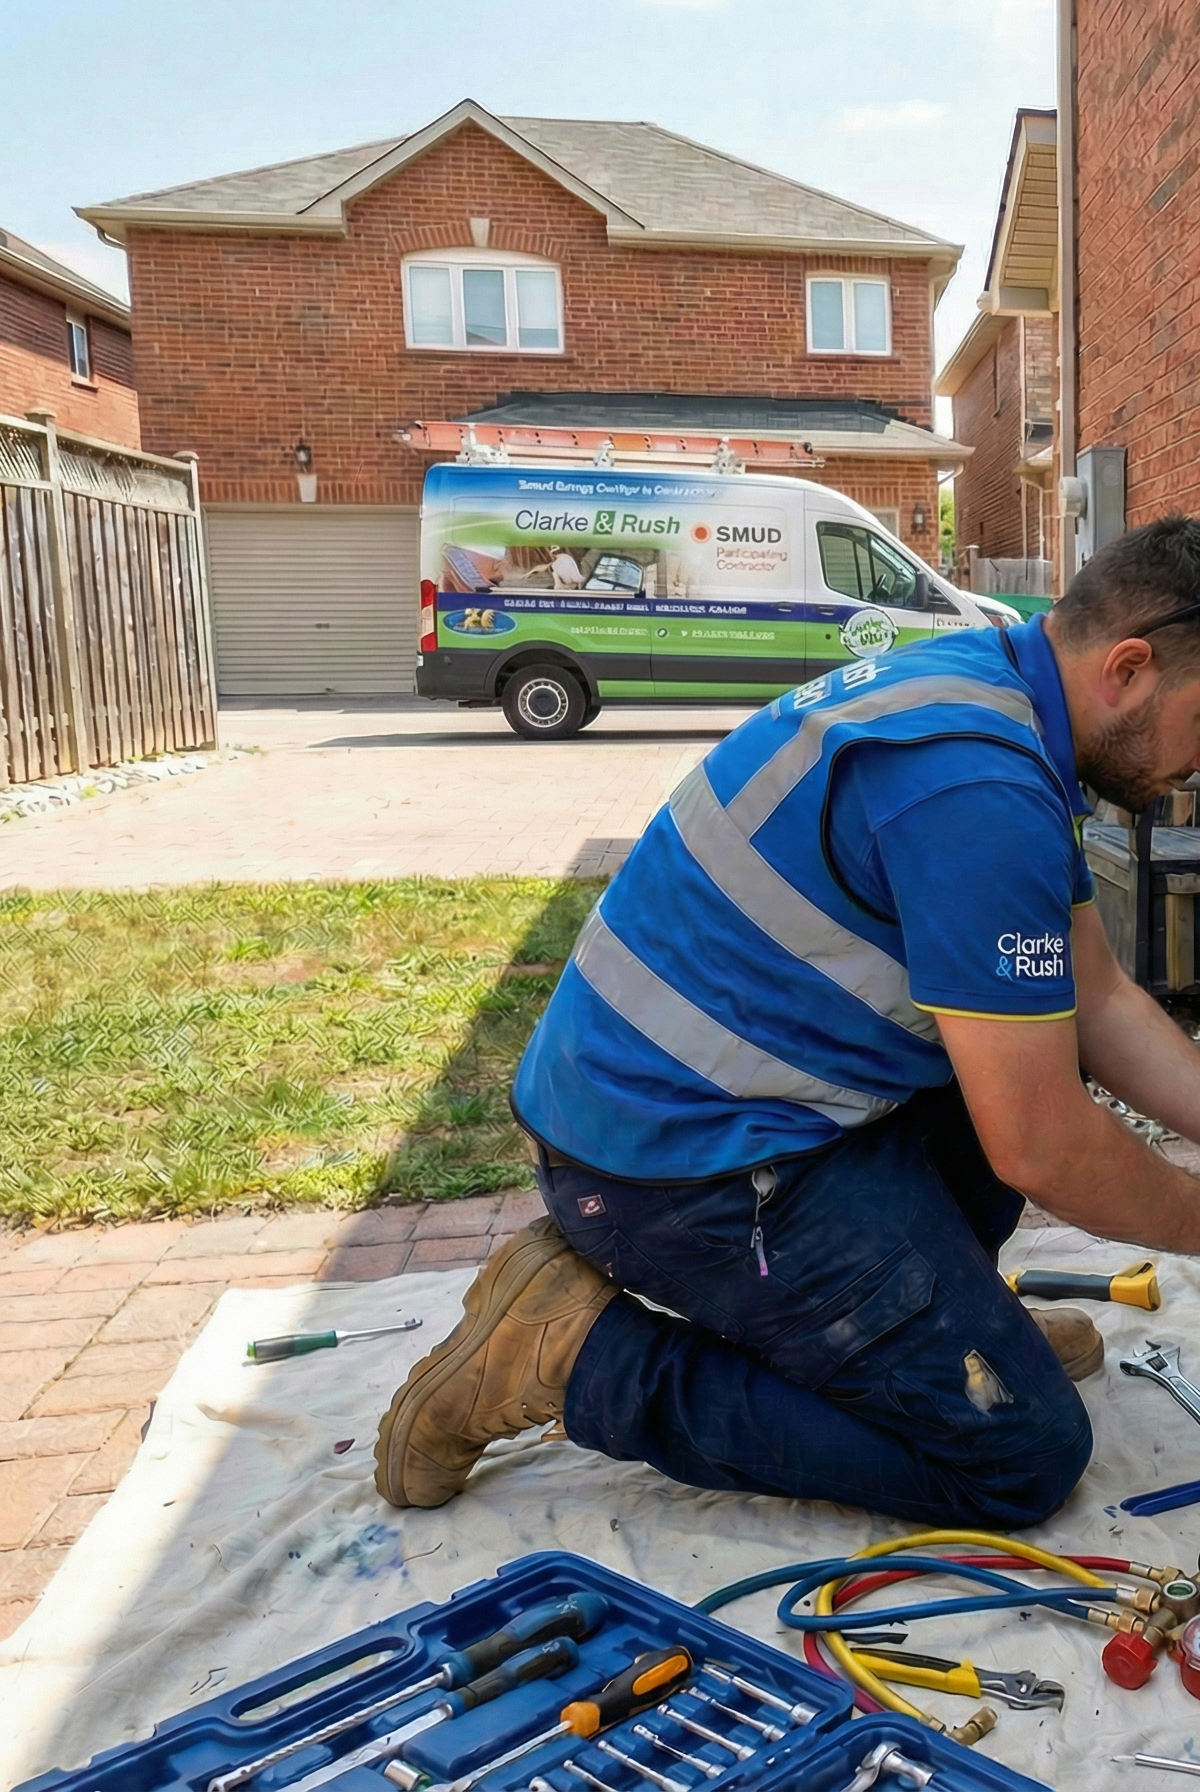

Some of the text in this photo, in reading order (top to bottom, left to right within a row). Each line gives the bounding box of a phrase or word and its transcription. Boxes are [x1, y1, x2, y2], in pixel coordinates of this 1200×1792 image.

[515, 509, 681, 534] Clarke & Rush
[716, 525, 782, 543] SMUD
[997, 931, 1064, 954] Clarke
[995, 953, 1064, 981] & Rush
